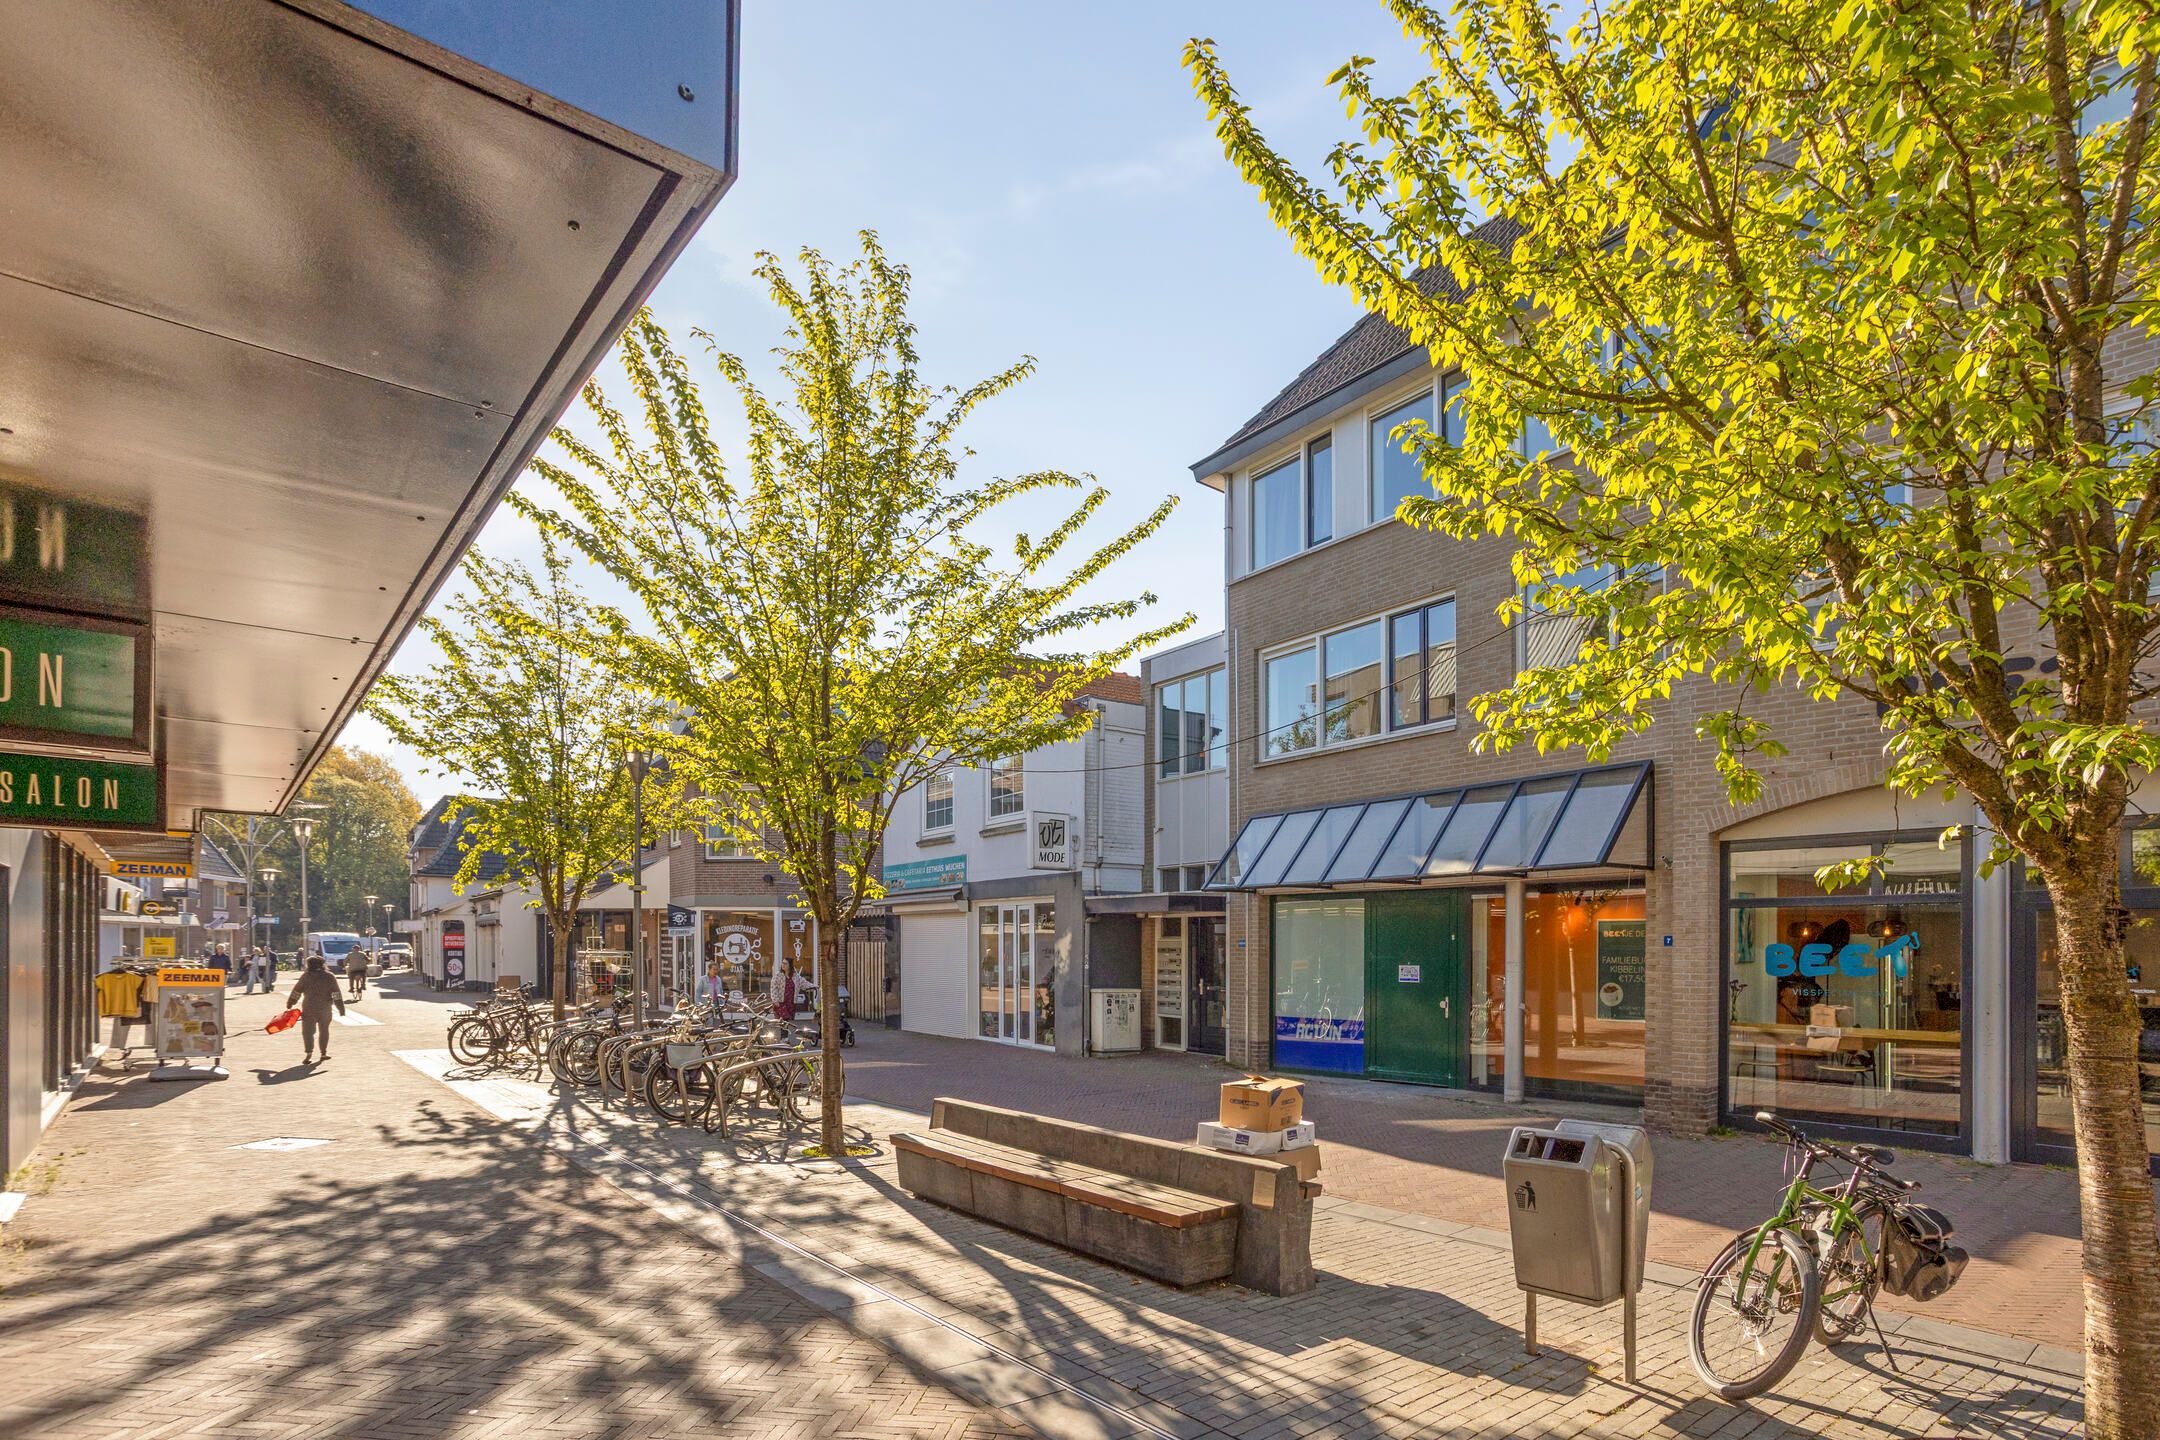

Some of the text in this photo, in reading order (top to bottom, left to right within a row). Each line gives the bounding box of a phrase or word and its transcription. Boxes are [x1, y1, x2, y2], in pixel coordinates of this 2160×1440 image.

[0, 770, 118, 810] SALON
[1039, 851, 1065, 863] MODE
[117, 863, 187, 876] ZEEMAN
[1602, 955, 1646, 965] FAMILIEBU
[1765, 931, 1921, 977] BEET
[1610, 965, 1646, 973] KIBBELIN
[163, 973, 220, 982] ZEEMAN
